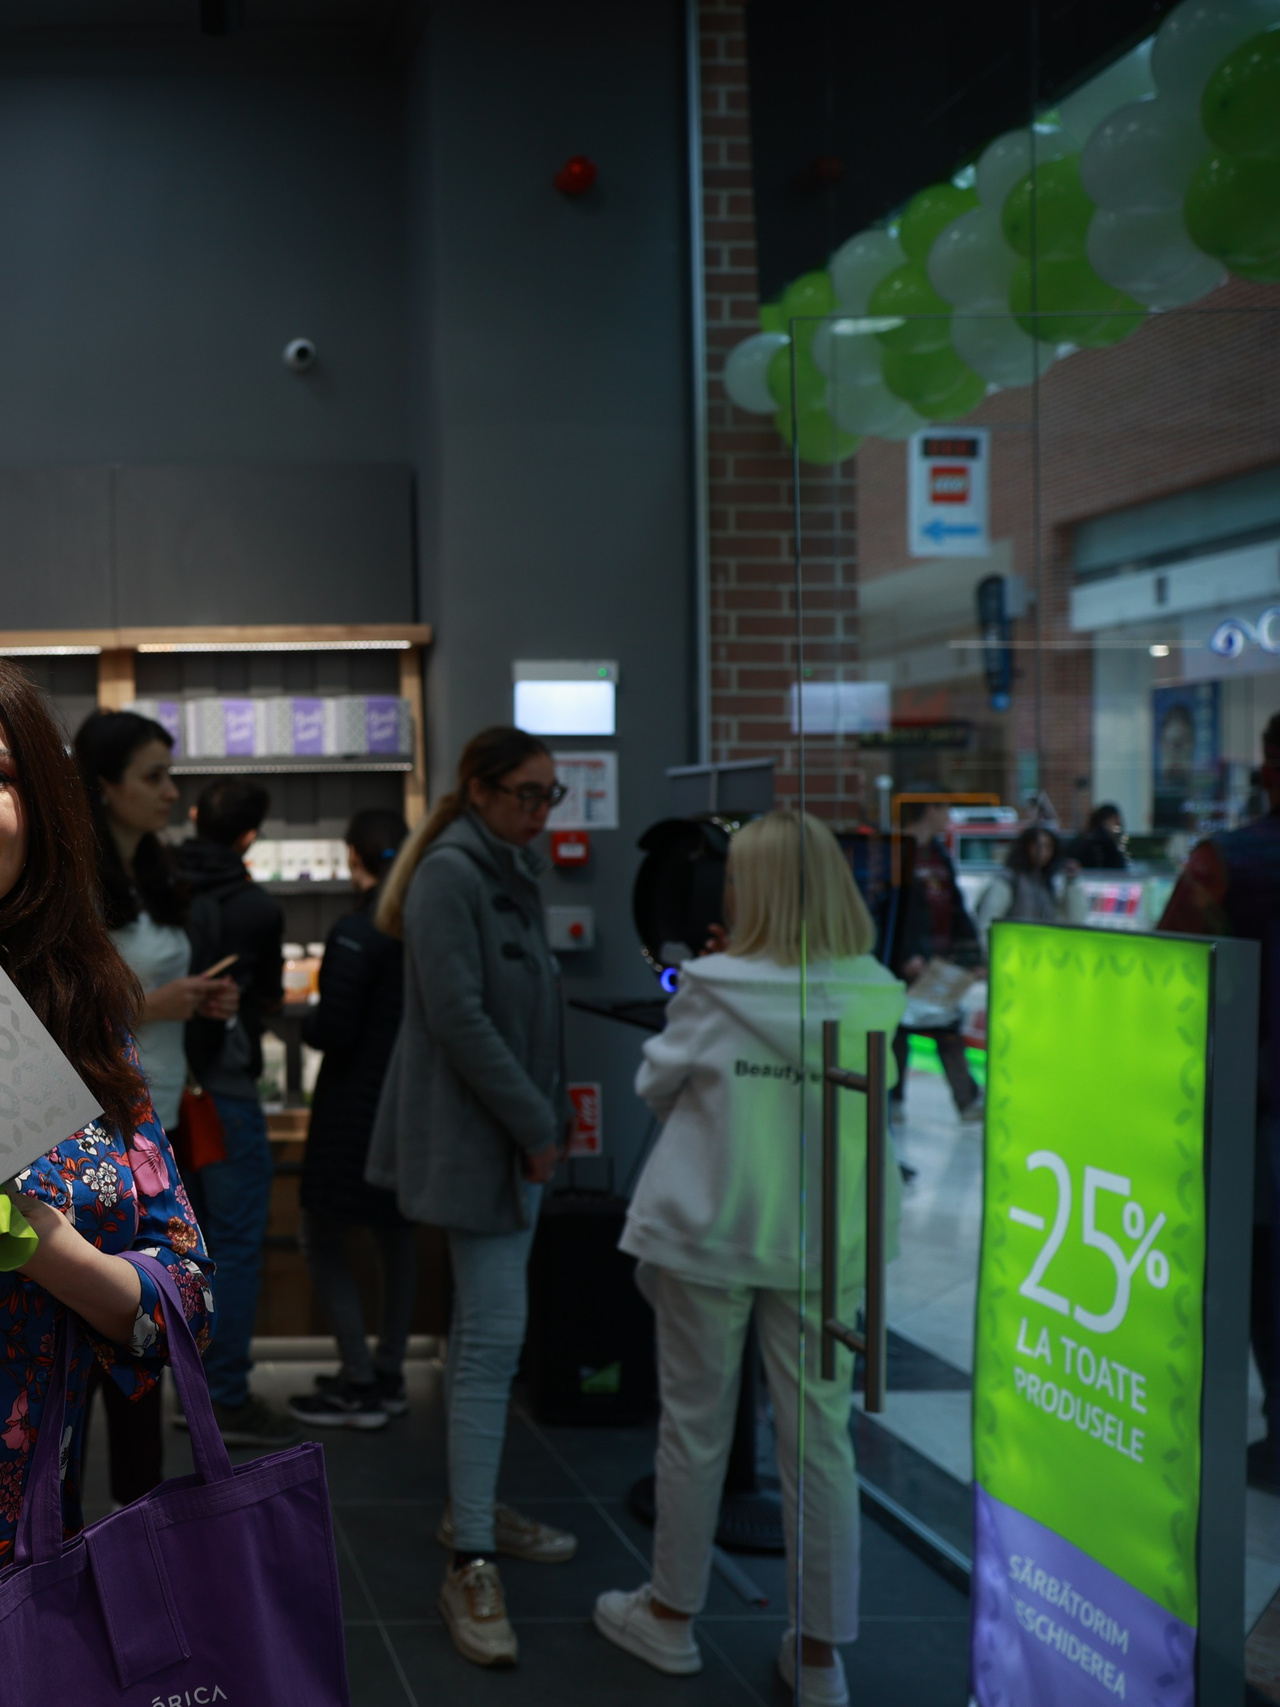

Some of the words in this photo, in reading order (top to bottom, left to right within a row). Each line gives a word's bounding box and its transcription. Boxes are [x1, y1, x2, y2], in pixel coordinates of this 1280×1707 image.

[735, 1060, 804, 1084] Beauty
[1008, 1149, 1170, 1334] -25%
[1014, 1365, 1145, 1464] PRODUSELE
[1016, 1316, 1053, 1366] LA
[1060, 1335, 1147, 1415] TOATE
[1008, 1554, 1130, 1656] SĂRBĂTORIM
[1012, 1594, 1126, 1702] ESCHIDEREA
